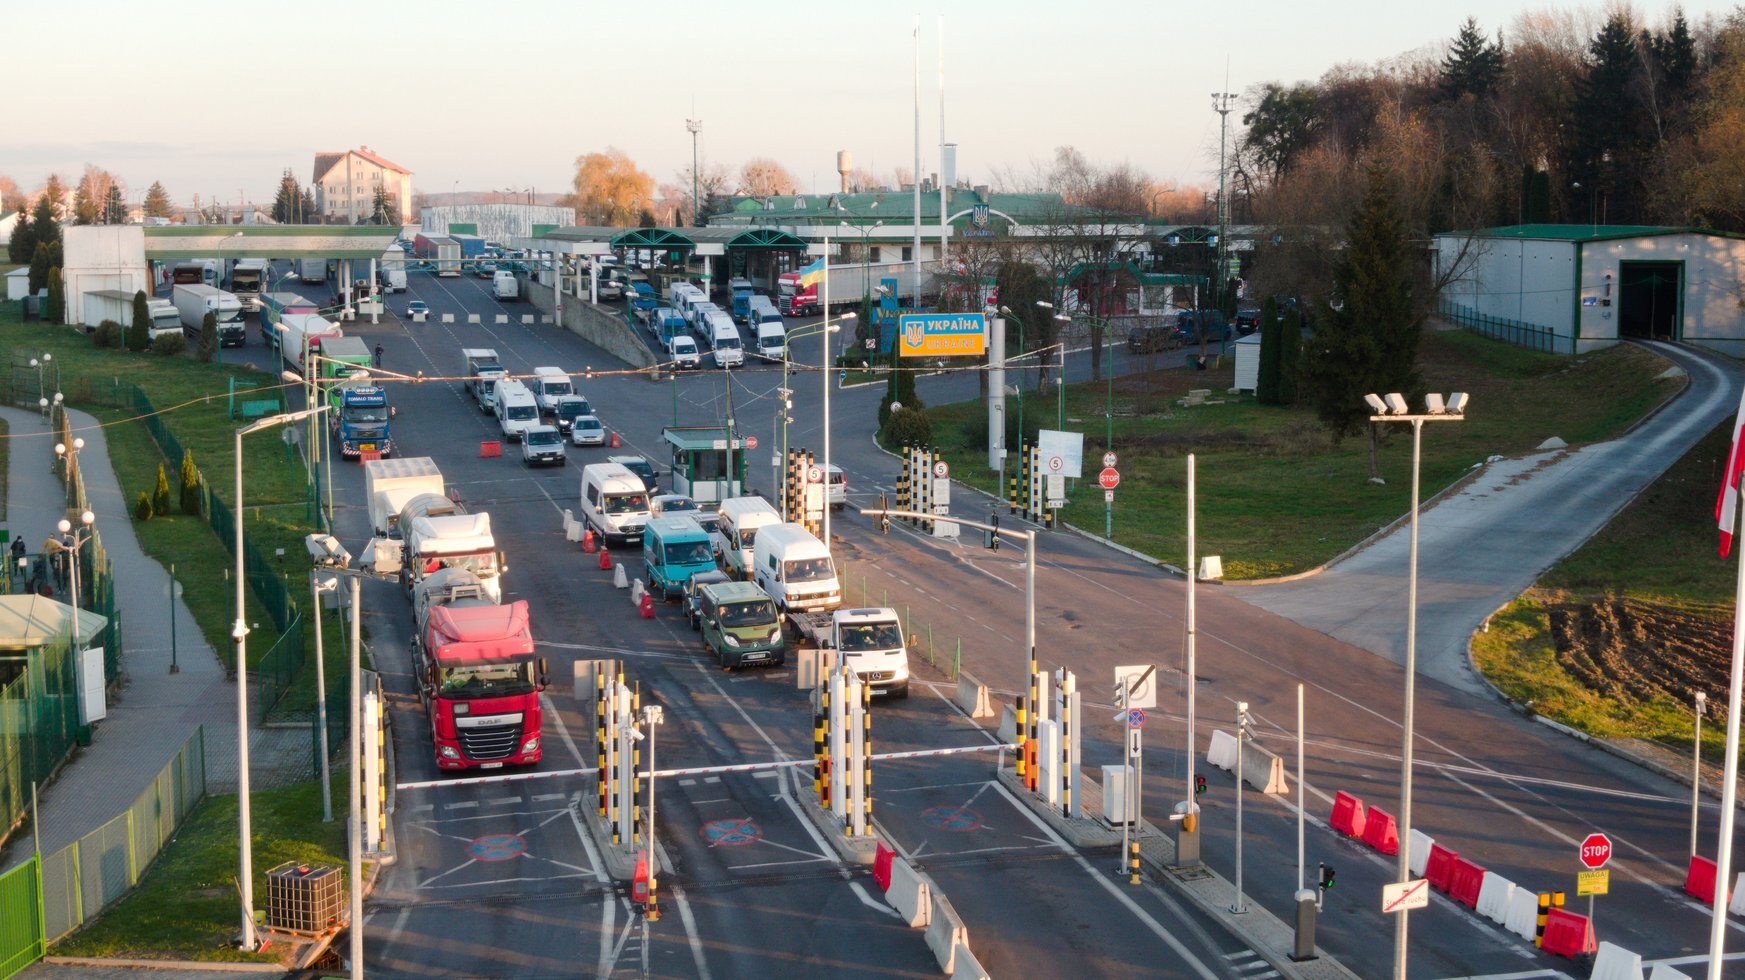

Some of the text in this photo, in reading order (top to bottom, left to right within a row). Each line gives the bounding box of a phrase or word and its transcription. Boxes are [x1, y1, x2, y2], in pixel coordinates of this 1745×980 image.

[927, 318, 979, 331] УКРАЇНА
[926, 338, 976, 349] UKRAINE
[1053, 459, 1059, 468] 5
[939, 465, 944, 474] 5
[811, 470, 818, 479] 5
[1100, 474, 1119, 482] STOP
[1583, 845, 1609, 857] STOP
